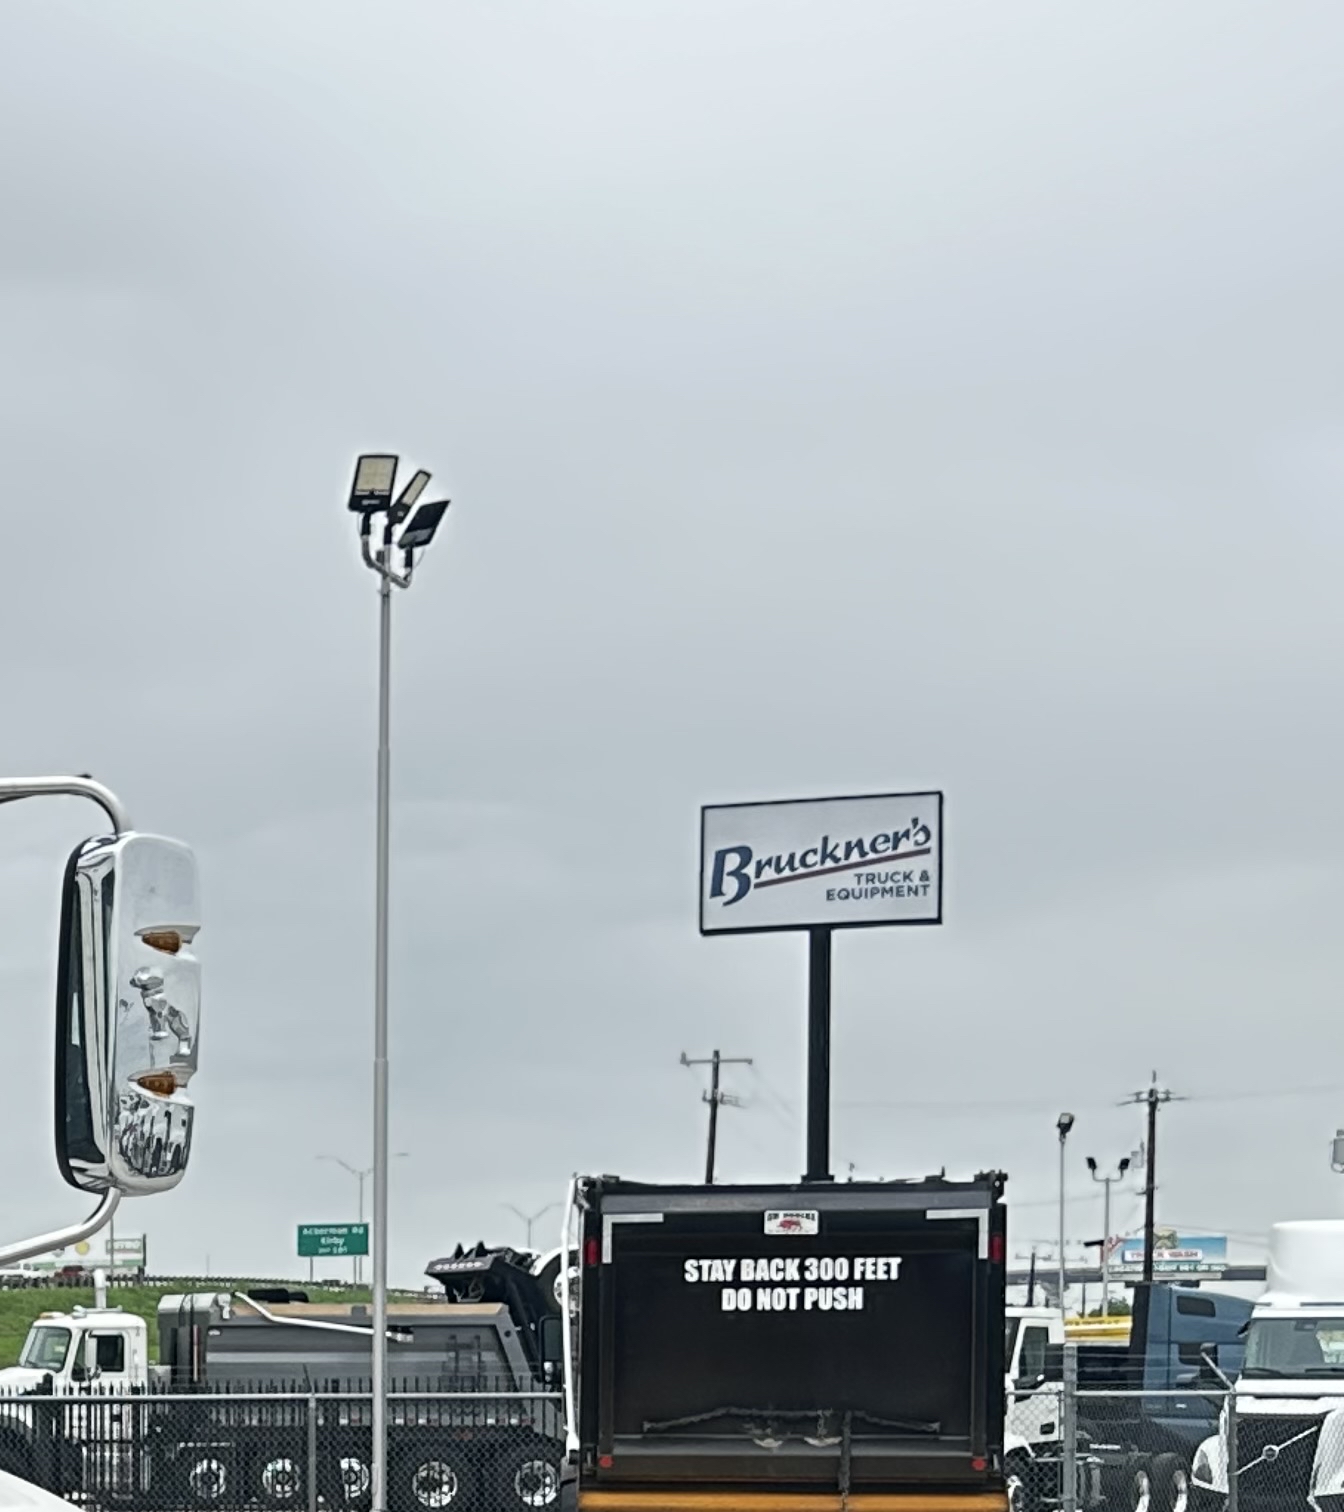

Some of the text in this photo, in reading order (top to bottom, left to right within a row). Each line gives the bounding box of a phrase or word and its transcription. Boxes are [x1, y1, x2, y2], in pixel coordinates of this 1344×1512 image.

[709, 816, 932, 907] Bruckner's
[854, 870, 931, 886] TRUCK &
[826, 884, 931, 902] EQUIPMENT
[684, 1257, 902, 1282] STAY BACK 300 FEET
[721, 1286, 864, 1311] DO NOT PUSH
